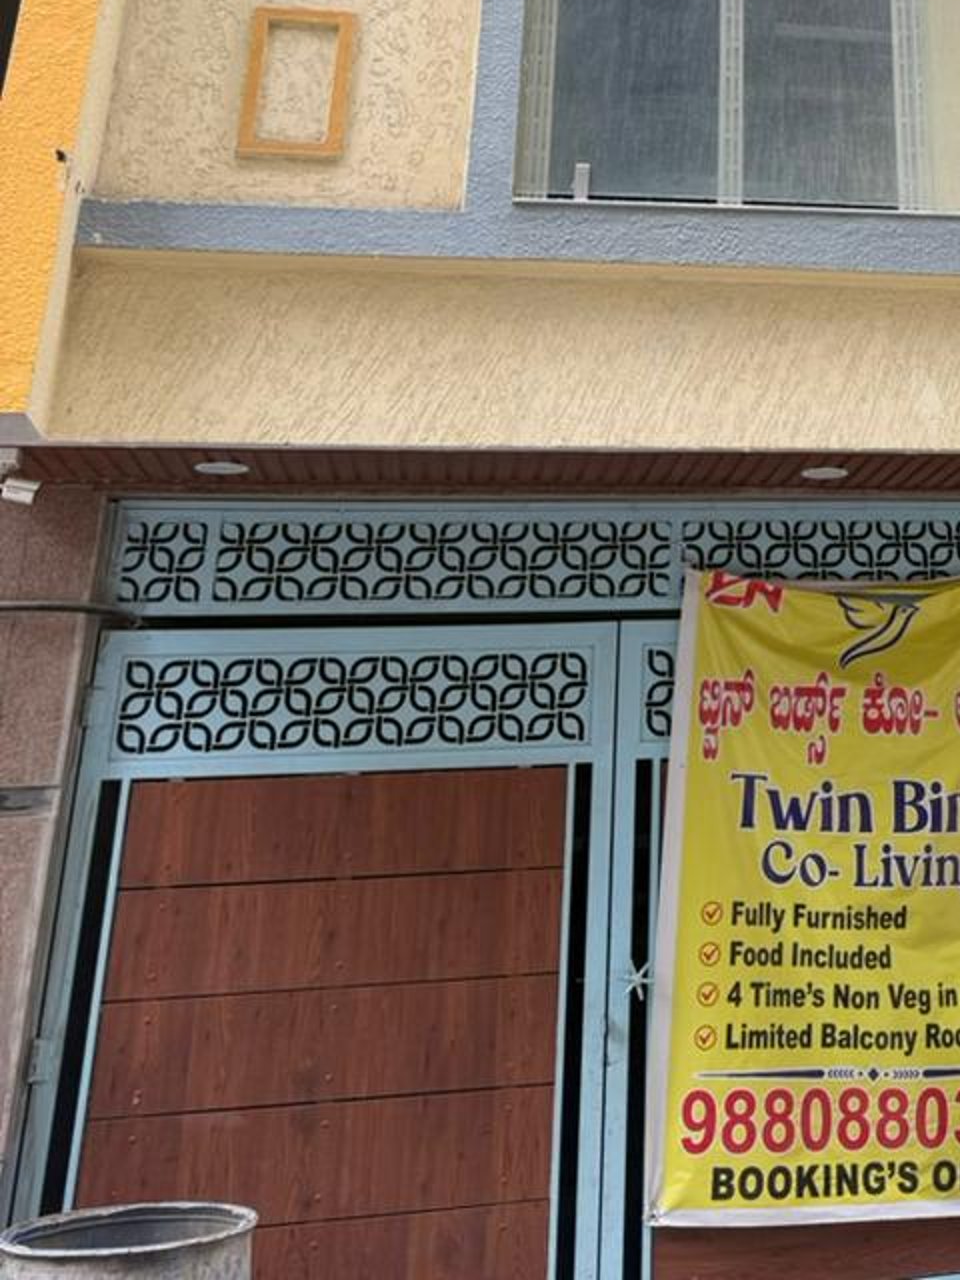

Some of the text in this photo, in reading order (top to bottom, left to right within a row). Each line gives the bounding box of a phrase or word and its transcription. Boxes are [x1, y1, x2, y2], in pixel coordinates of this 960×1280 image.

[731, 773, 873, 833] Twin
[731, 901, 907, 934] Fully Furnished
[730, 941, 891, 970] Food Included
[727, 981, 742, 1007] 4
[750, 981, 825, 1008] Time's
[833, 984, 880, 1009] Non
[888, 983, 931, 1015] Veg
[938, 982, 958, 1007] in
[725, 1023, 813, 1049] Limited
[821, 1023, 917, 1057] Balcony
[711, 1161, 919, 1201] BOOKING'S
